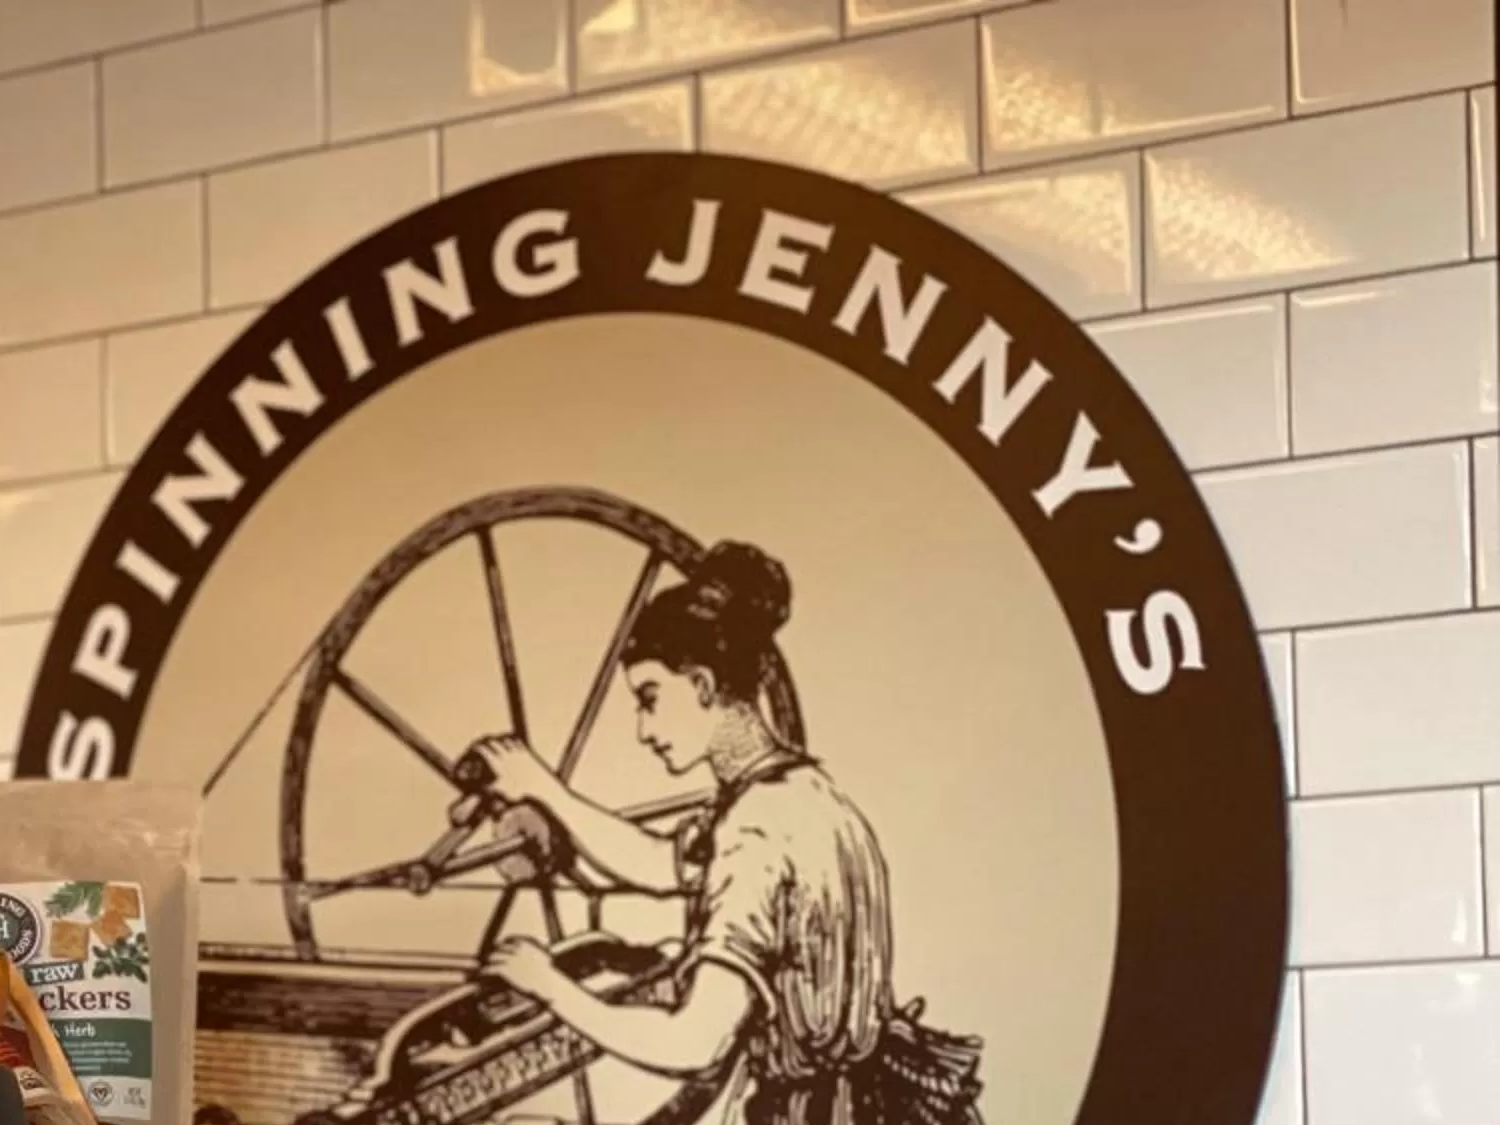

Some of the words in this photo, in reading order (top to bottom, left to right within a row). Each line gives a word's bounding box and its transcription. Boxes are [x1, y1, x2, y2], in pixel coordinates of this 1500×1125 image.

[48, 209, 580, 780] SPINNING
[644, 199, 1206, 696] JENNY'S
[29, 962, 80, 984] raw
[63, 1022, 97, 1038] Herb
